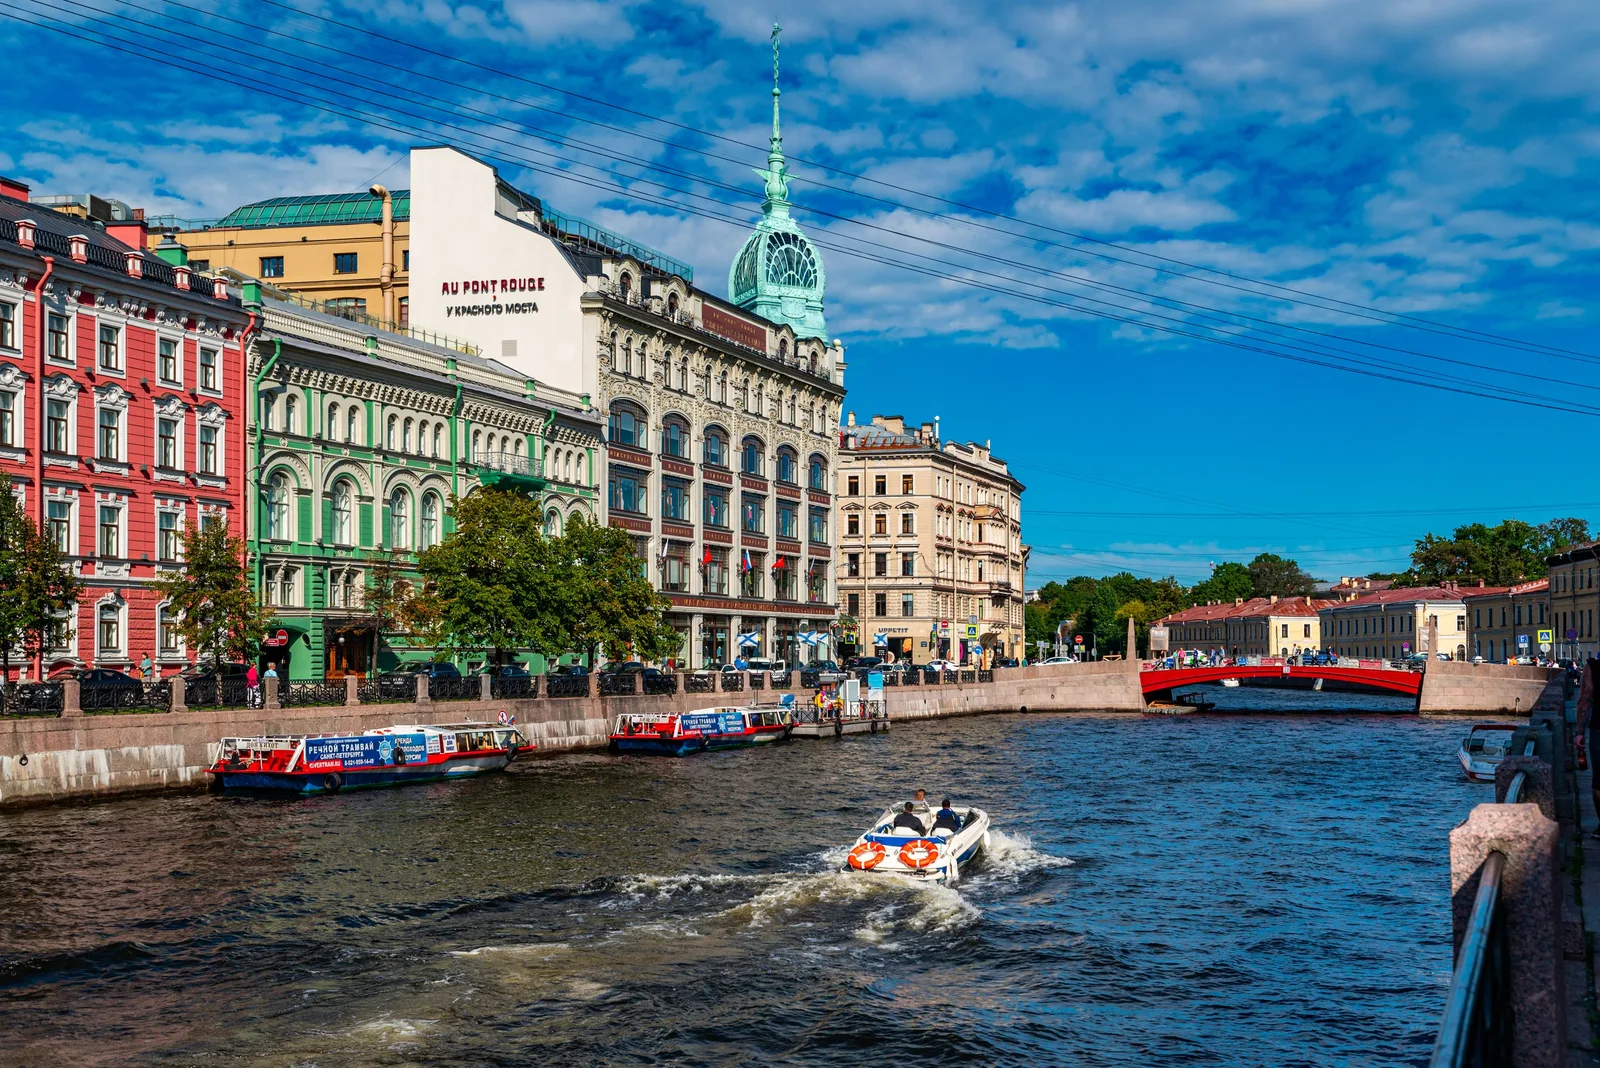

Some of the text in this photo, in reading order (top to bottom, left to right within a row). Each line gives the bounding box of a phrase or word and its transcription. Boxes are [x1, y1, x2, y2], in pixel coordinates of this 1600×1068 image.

[442, 278, 546, 296] AU PONT ROUGE
[446, 302, 538, 317] У КРАСНОГО МОСТА
[309, 741, 374, 754] РЕЧНОЙ ТРАМВАЙ
